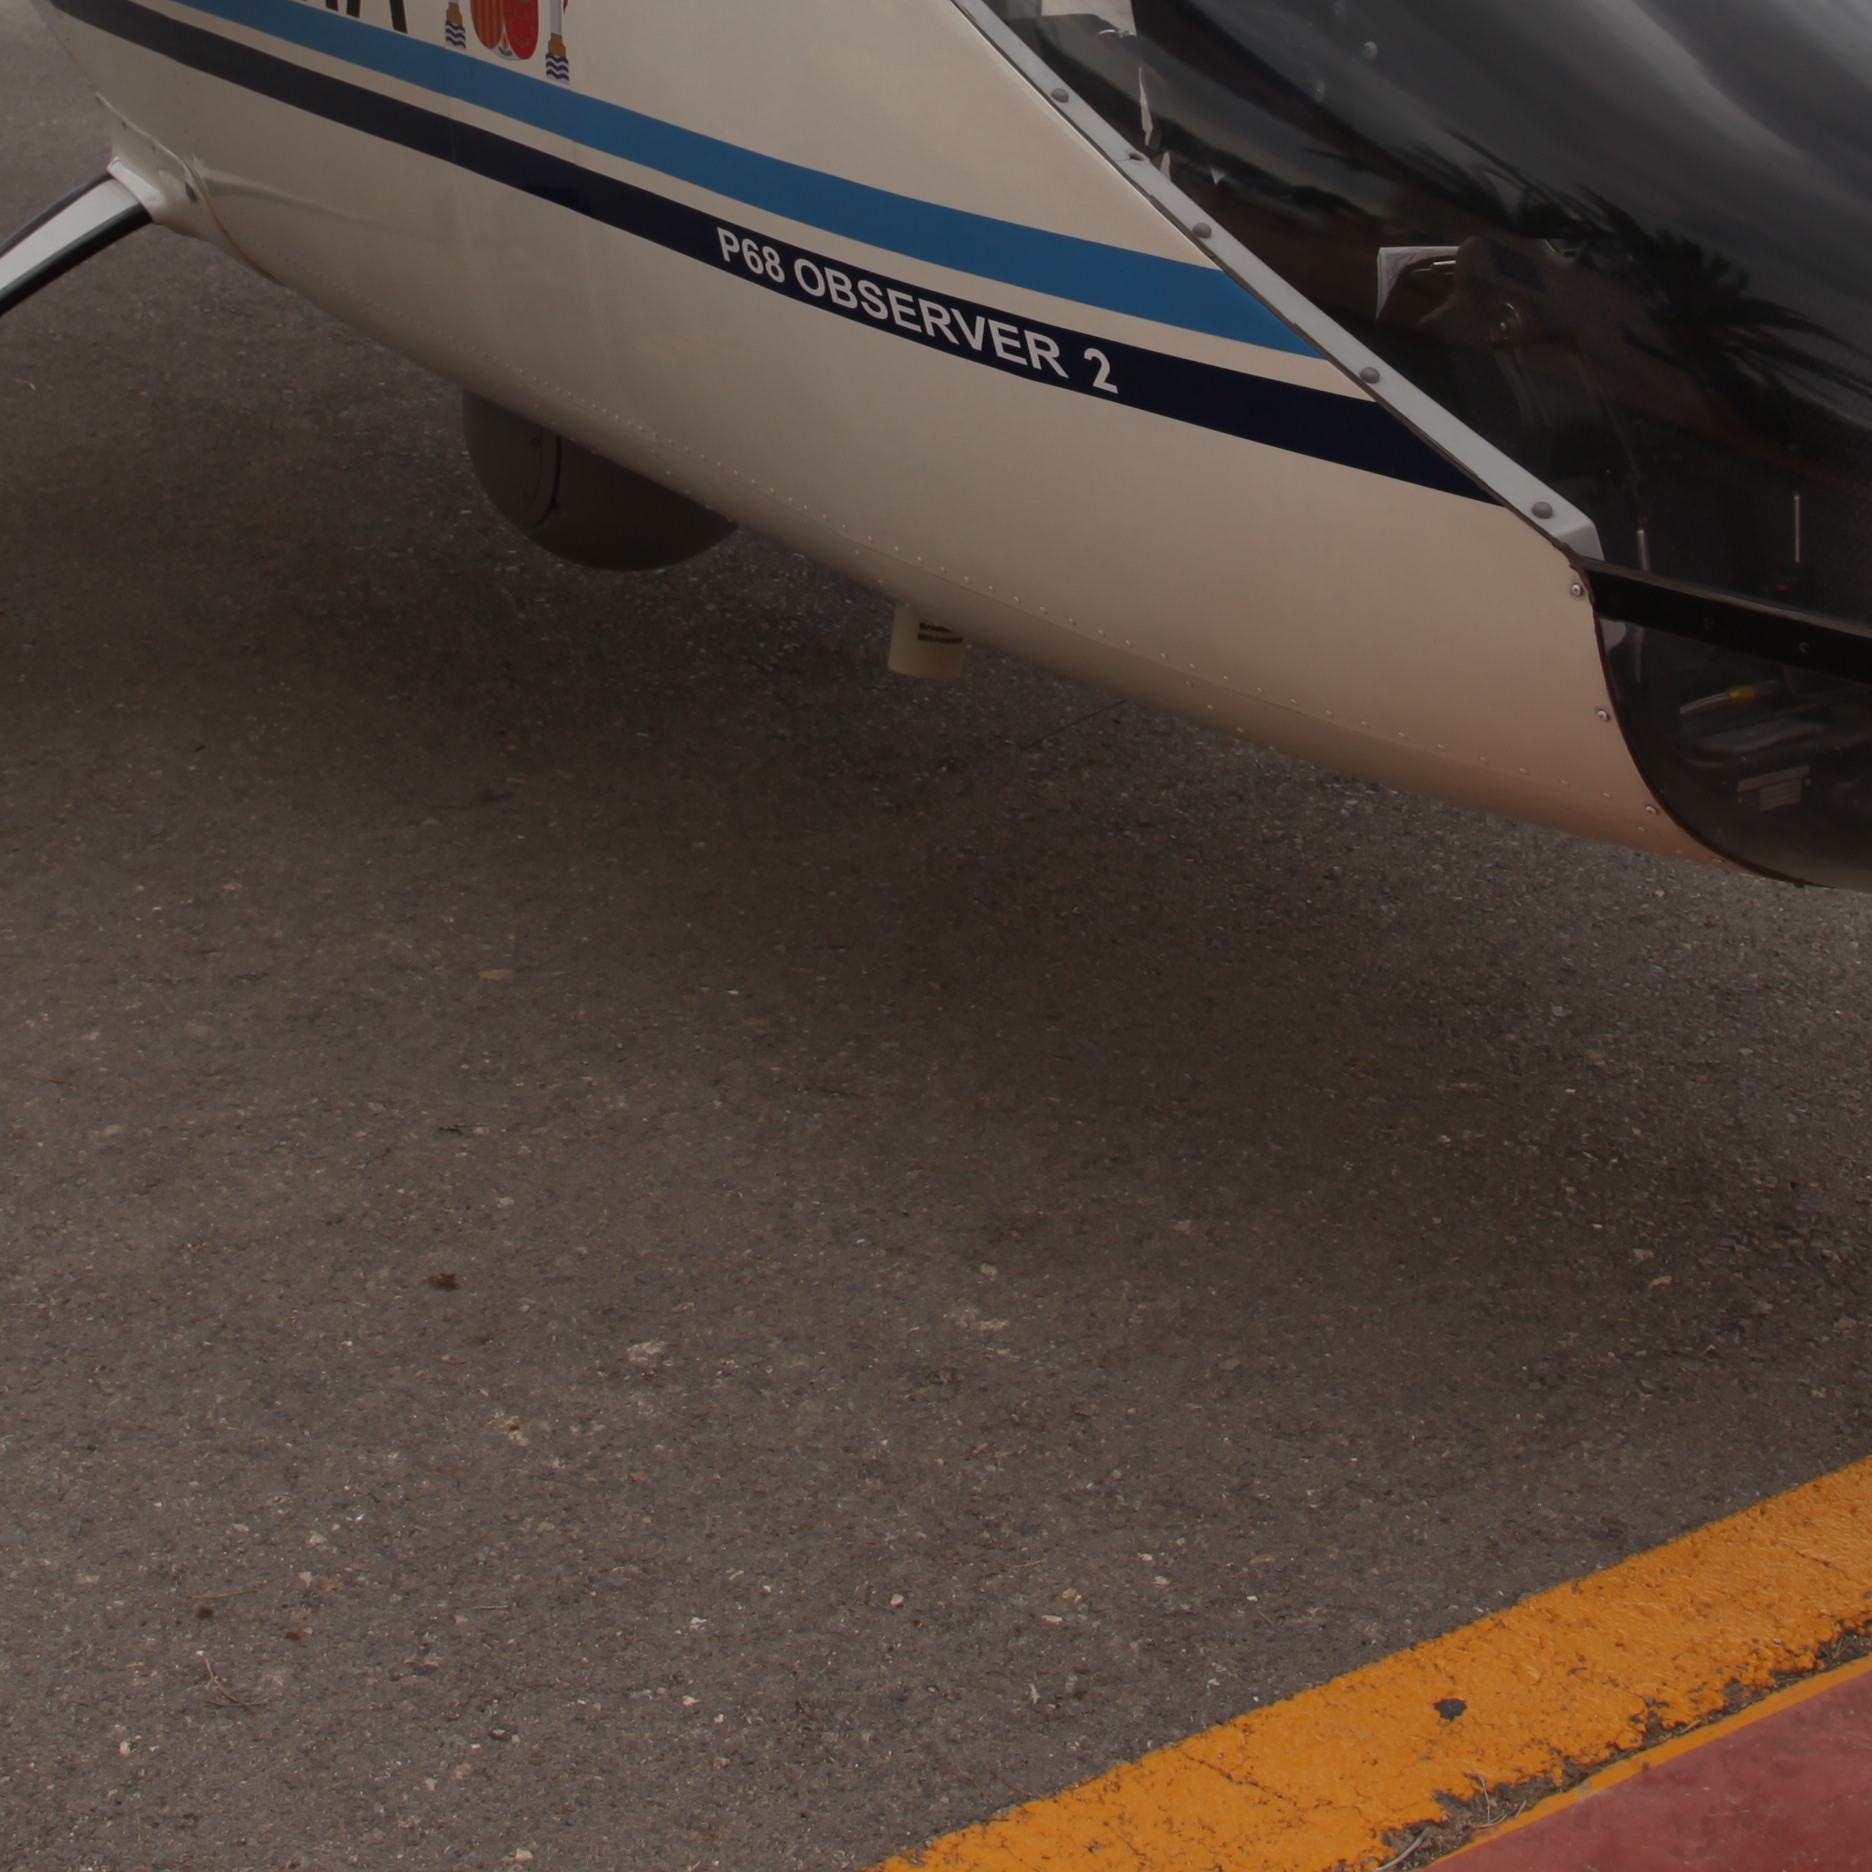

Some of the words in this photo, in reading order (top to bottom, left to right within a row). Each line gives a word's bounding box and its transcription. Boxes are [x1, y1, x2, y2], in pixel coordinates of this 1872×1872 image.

[716, 226, 786, 284] P68
[794, 258, 1070, 379] OBSERVER
[1083, 347, 1119, 394] 2
